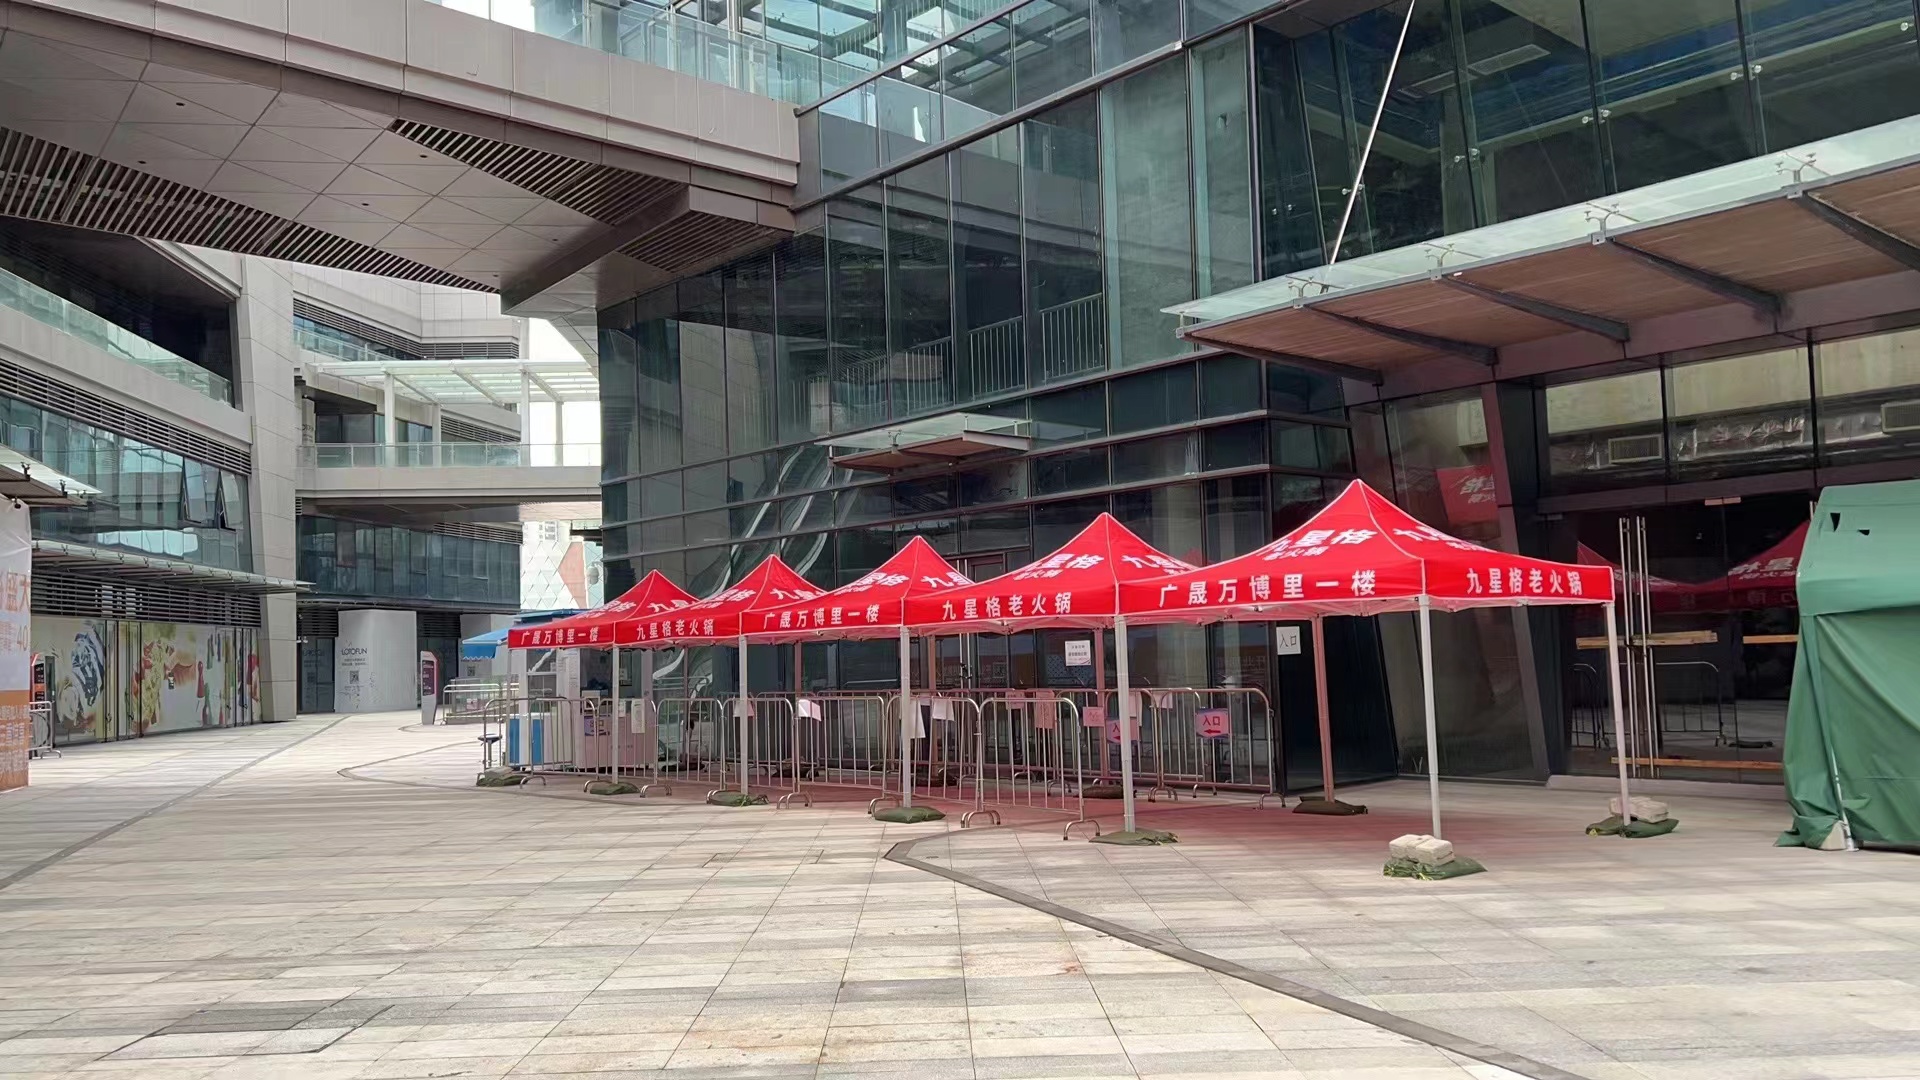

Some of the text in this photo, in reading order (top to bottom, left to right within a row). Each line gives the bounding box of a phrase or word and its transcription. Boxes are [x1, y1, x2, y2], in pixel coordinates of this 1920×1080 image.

[1159, 569, 1376, 608] 广晟万博里一楼
[1466, 567, 1583, 596] 九星格老火锅
[763, 603, 881, 630] 广晟万博里一楼
[942, 591, 1073, 621] 九星格老火锅
[520, 626, 599, 645] 广晟万博里一楼
[636, 618, 714, 641] 九星格老火锅
[1279, 634, 1298, 649] 入口
[1202, 714, 1221, 727] 入口
